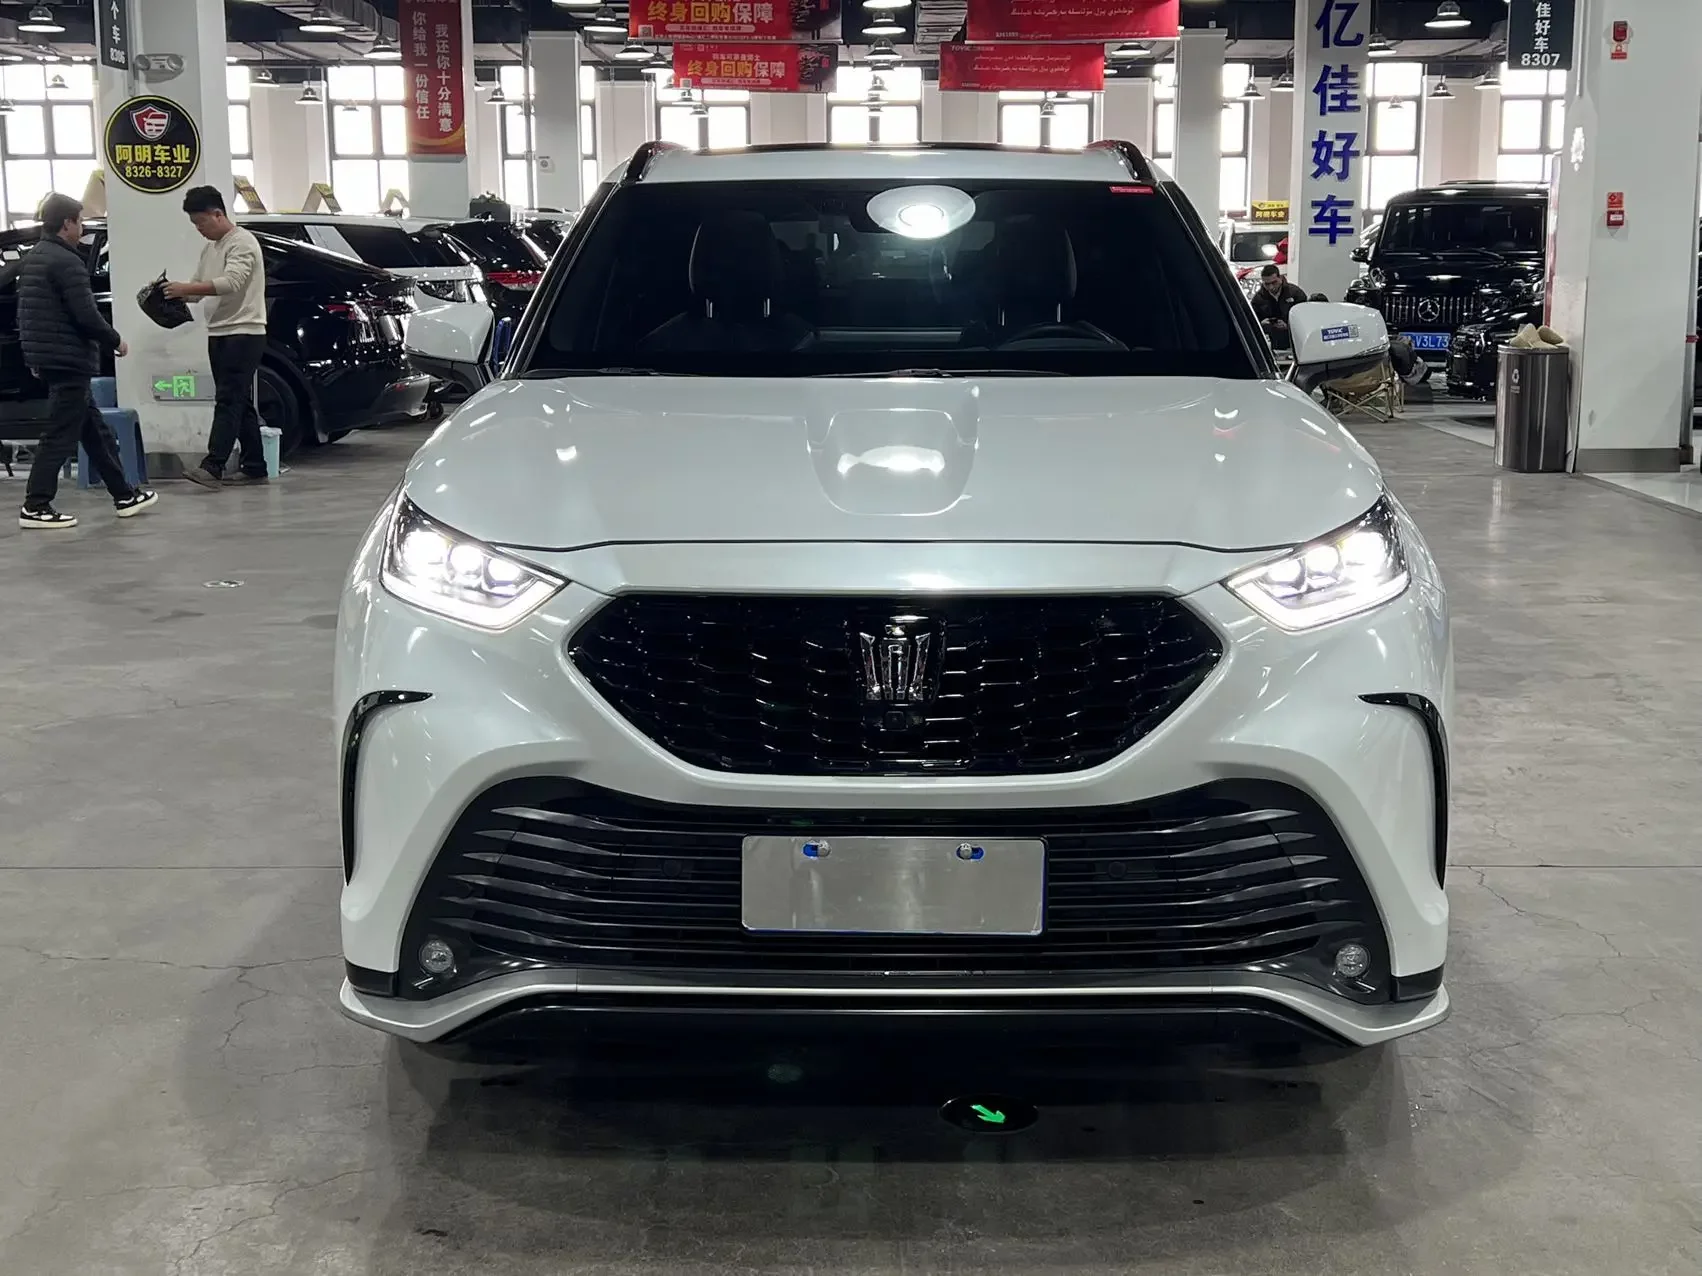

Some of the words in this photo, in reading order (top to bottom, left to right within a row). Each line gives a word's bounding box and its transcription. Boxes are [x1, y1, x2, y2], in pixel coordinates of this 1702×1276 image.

[647, 2, 774, 24] 终身回购保障
[1533, 2, 1552, 52] 佳好车
[412, 11, 430, 120] 你给我一份信任
[687, 60, 786, 79] 终身回购保障
[1521, 53, 1560, 66] 8307
[435, 24, 453, 133] 我还你十分满意
[1308, 0, 1364, 245] 亿佳好车
[115, 144, 190, 165] 阿明车业
[125, 165, 183, 178] 8326-8327
